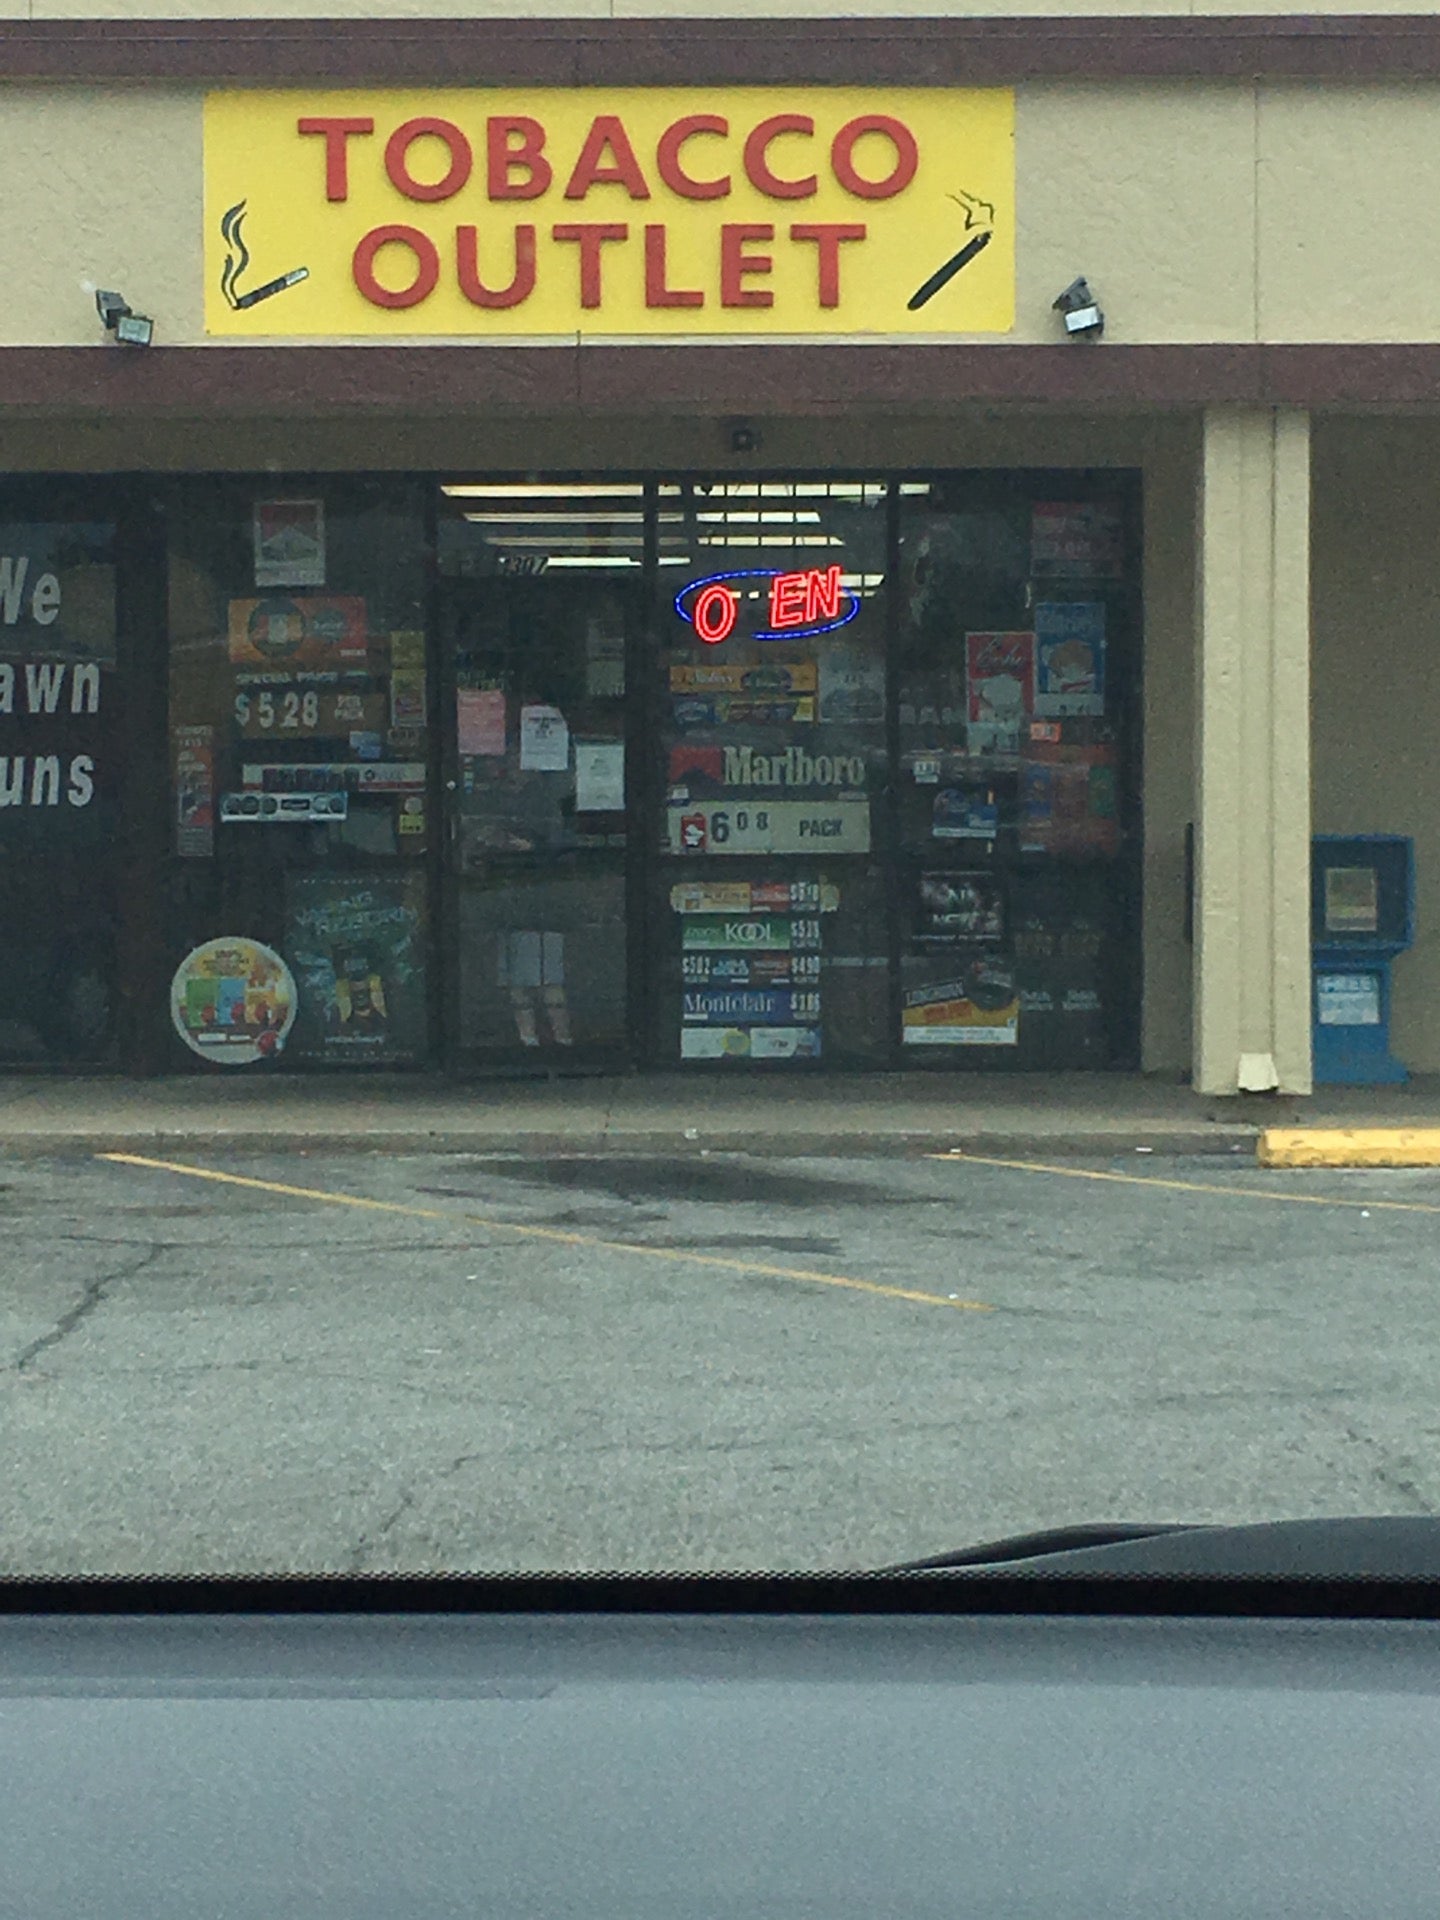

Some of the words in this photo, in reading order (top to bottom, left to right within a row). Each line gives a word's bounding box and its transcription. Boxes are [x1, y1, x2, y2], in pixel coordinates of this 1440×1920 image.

[297, 114, 919, 202] TOBACCO
[352, 223, 867, 311] OUTLET
[0, 557, 61, 626] We
[723, 746, 866, 786] Marlboro
[799, 819, 842, 837] PACK
[725, 922, 771, 941] KOOL
[684, 993, 775, 1013] Montclair
